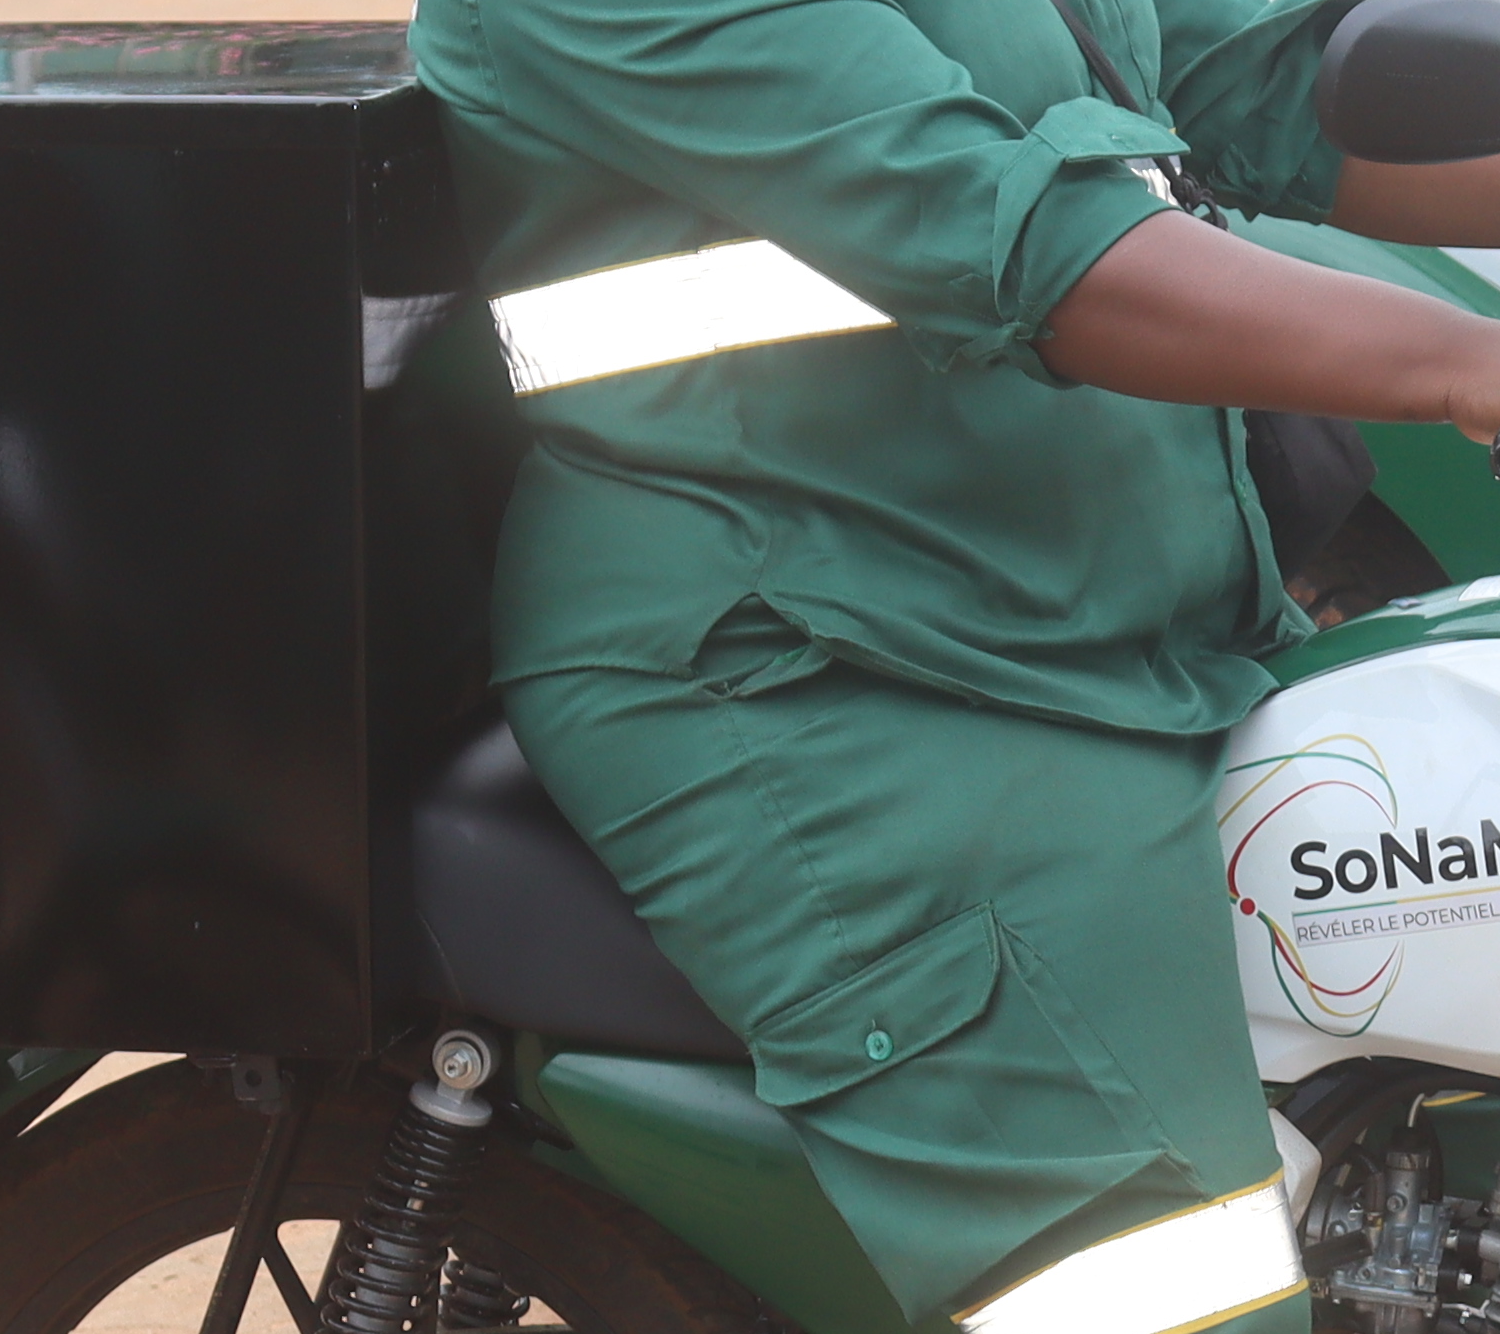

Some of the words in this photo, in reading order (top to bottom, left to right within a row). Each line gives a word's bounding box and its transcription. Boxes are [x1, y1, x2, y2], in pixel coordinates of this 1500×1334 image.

[1297, 917, 1375, 942] RÉVÉLER
[1378, 915, 1400, 932] LE
[1403, 902, 1500, 929] POTENTIEL
